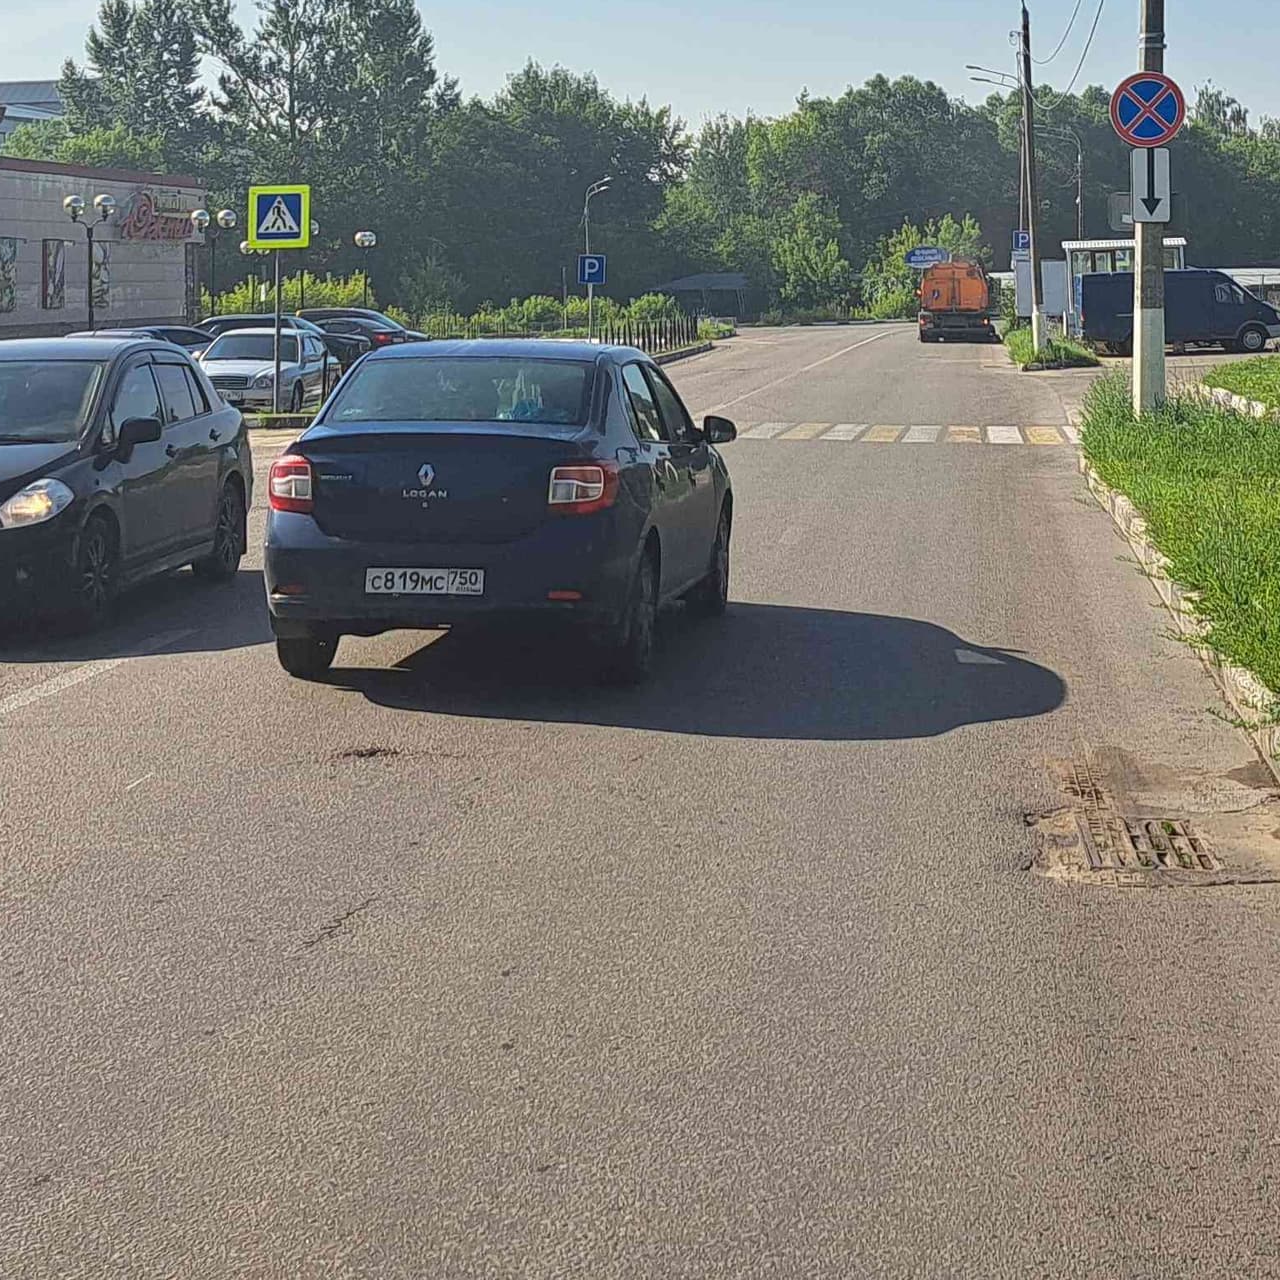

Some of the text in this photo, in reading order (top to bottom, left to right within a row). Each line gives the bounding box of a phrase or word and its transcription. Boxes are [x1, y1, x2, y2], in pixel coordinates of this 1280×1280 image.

[1018, 233, 1029, 248] P
[584, 258, 600, 281] P
[402, 489, 448, 498] LOGAN
[370, 570, 479, 591] С819МС 750
